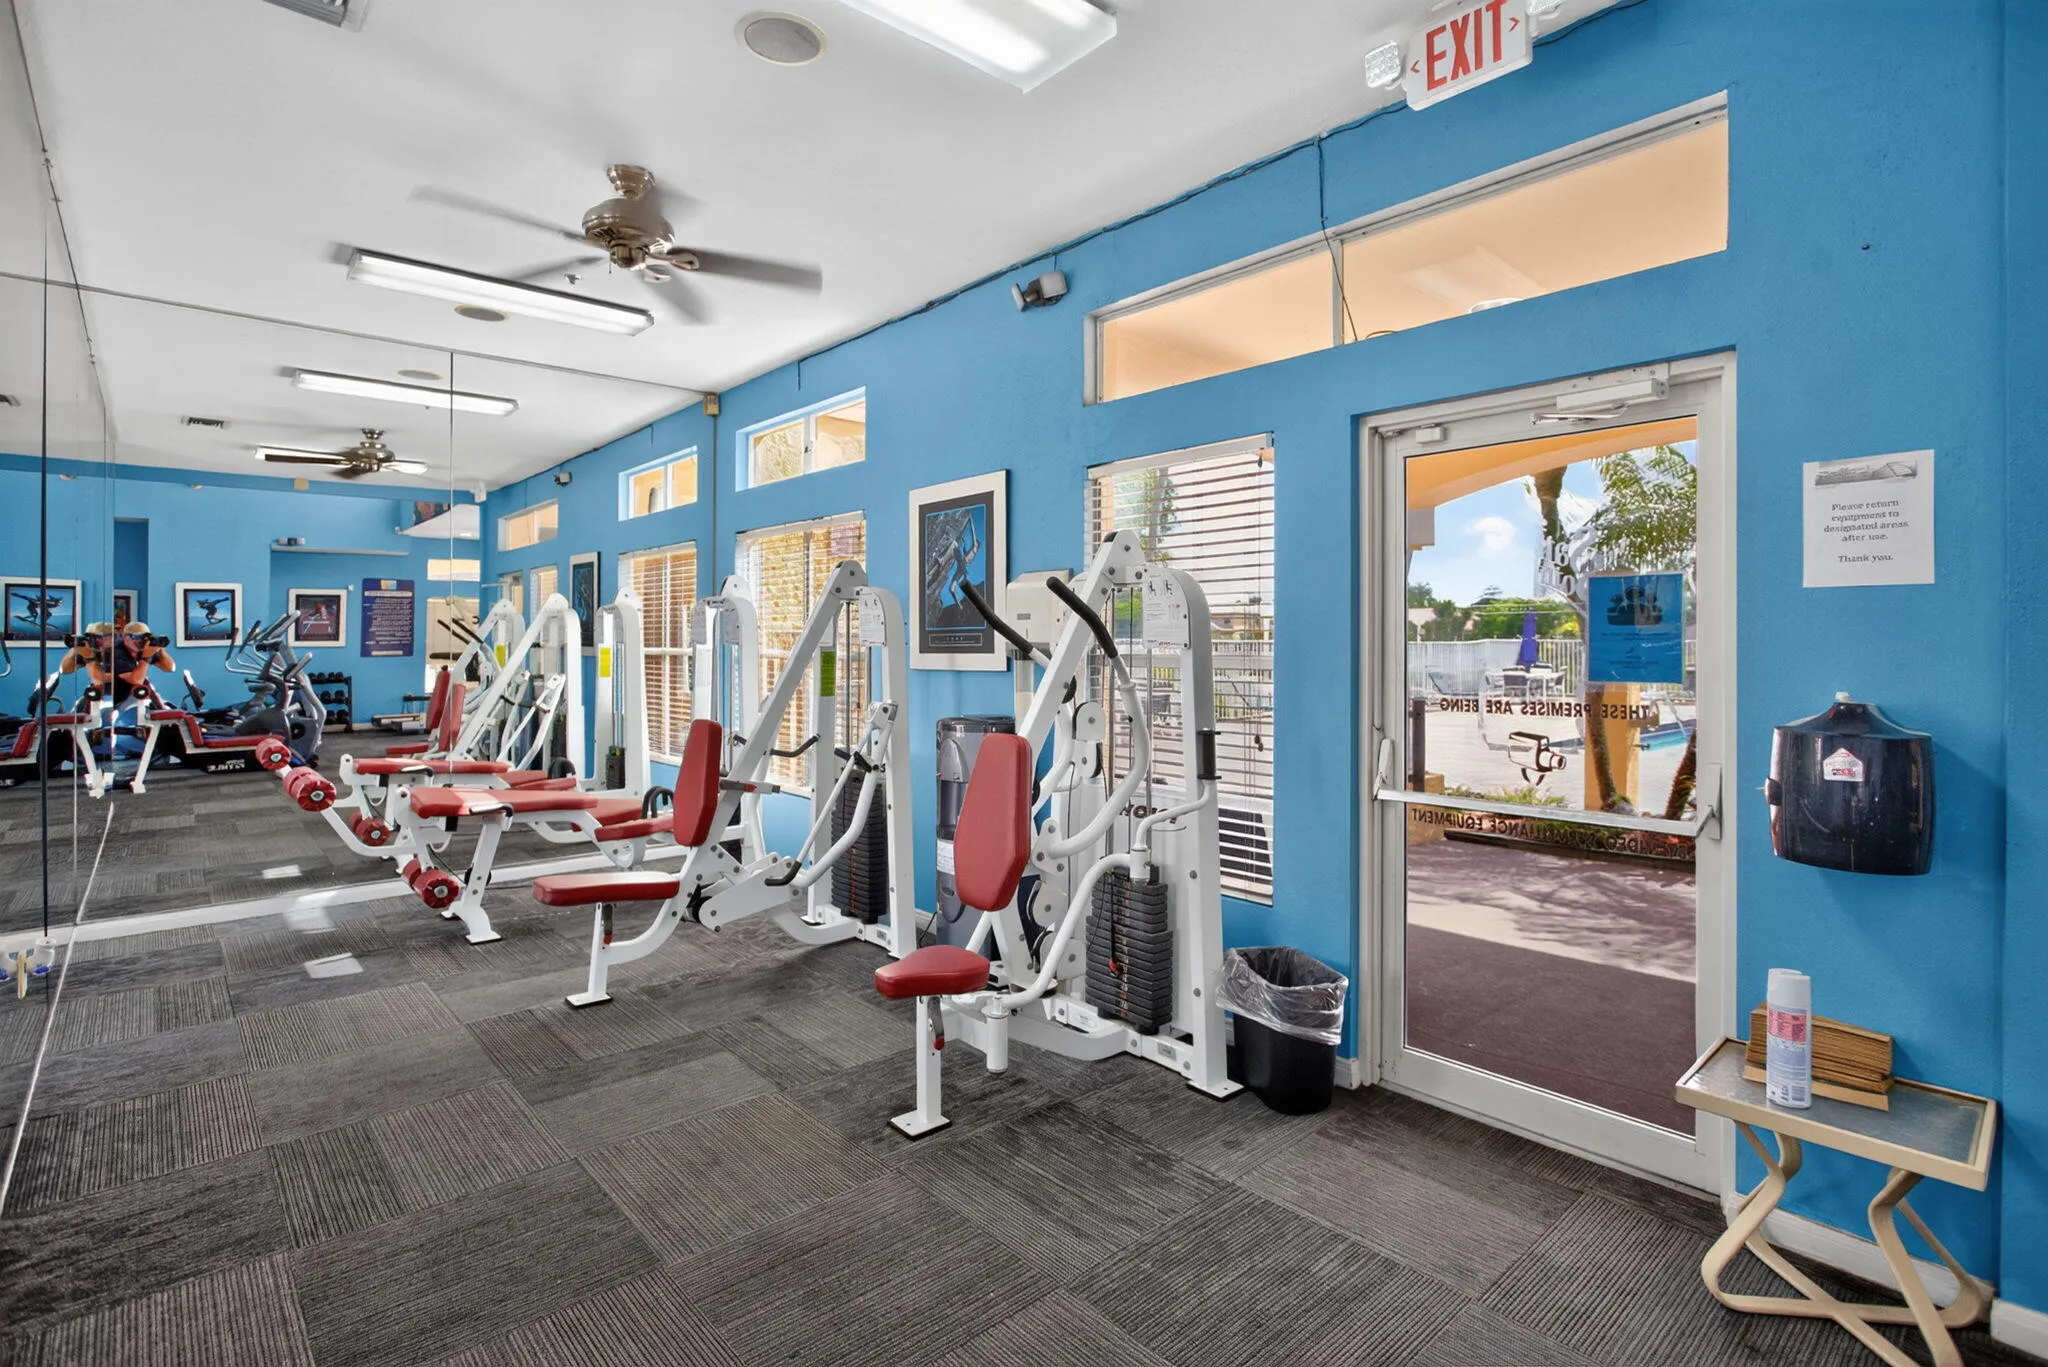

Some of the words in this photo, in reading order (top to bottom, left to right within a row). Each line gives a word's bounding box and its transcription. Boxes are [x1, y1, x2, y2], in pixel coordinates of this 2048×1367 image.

[1426, 0, 1508, 92] EXIT
[1832, 503, 1864, 511] Please
[1866, 500, 1899, 509] return
[1832, 511, 1886, 522] equipment
[1824, 522, 1878, 533] designated
[1880, 521, 1909, 529] areas
[1841, 534, 1866, 542] after
[1838, 554, 1870, 562] Thank
[1871, 554, 1894, 563] you.
